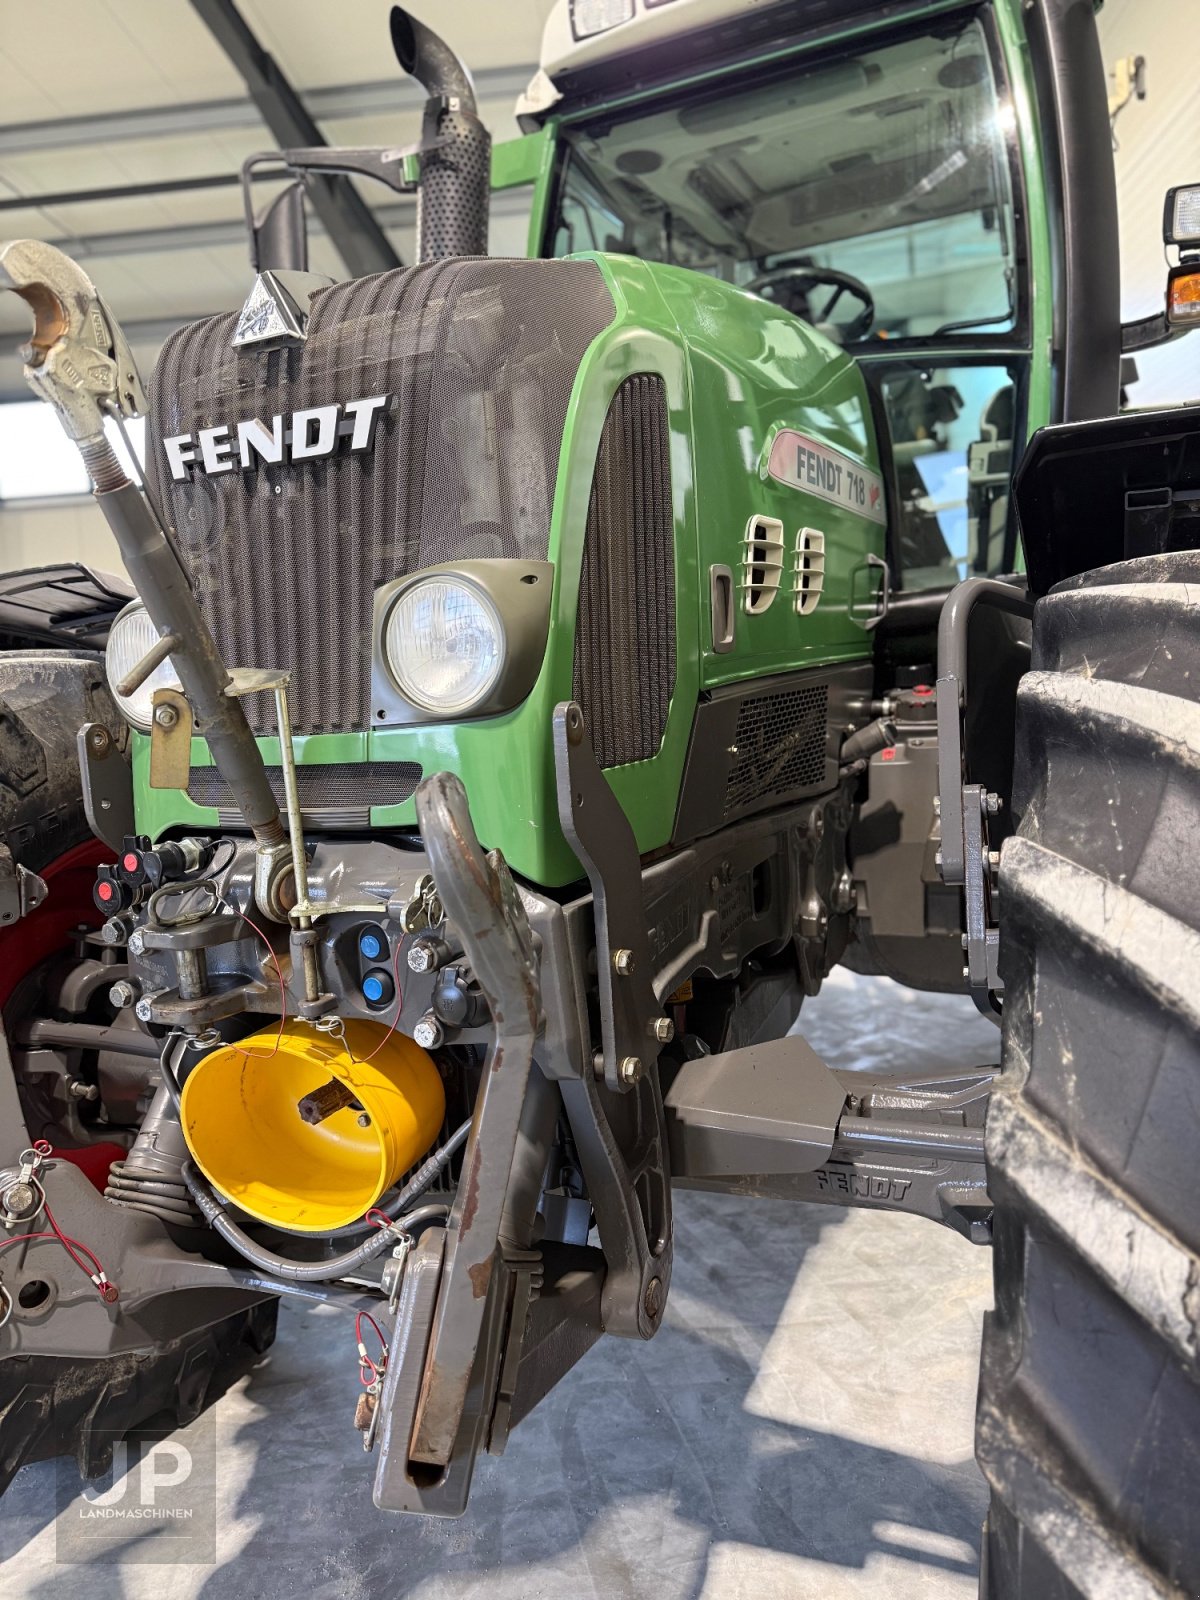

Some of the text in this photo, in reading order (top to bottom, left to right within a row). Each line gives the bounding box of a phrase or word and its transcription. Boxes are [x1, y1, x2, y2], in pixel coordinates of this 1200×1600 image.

[163, 395, 389, 482] FENDT
[796, 445, 866, 506] FENDT 718
[813, 1169, 913, 1201] FENDT
